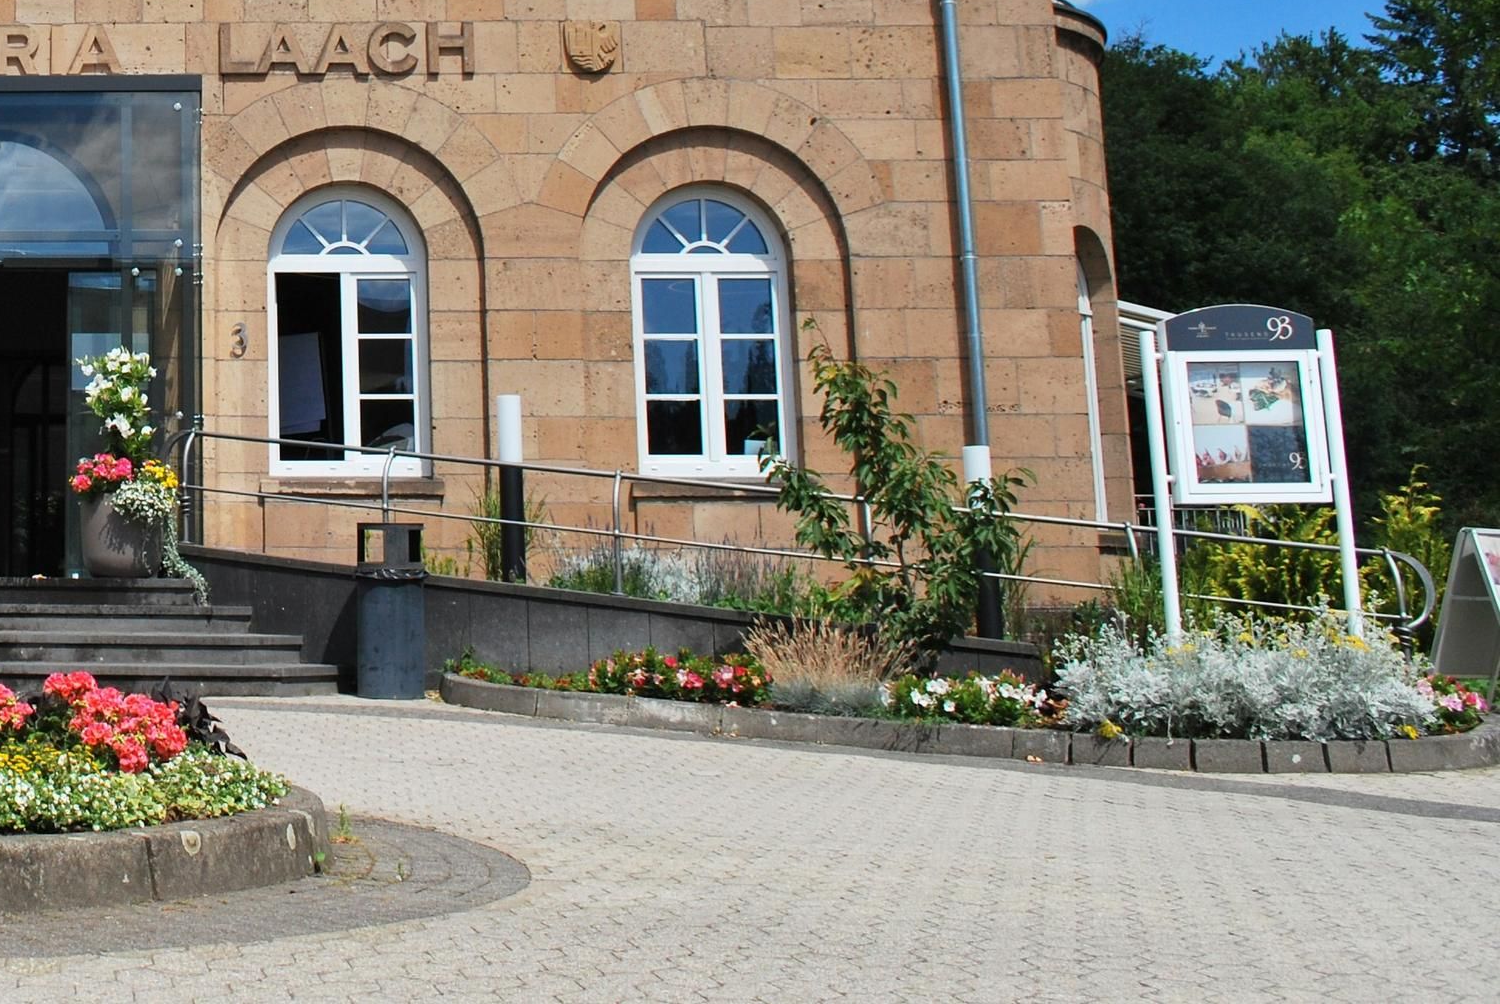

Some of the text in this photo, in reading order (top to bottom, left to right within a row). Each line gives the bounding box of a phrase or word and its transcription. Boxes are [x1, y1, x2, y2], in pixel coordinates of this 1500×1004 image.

[219, 22, 475, 79] LAACH
[230, 322, 248, 359] 3
[1266, 316, 1293, 342] 93
